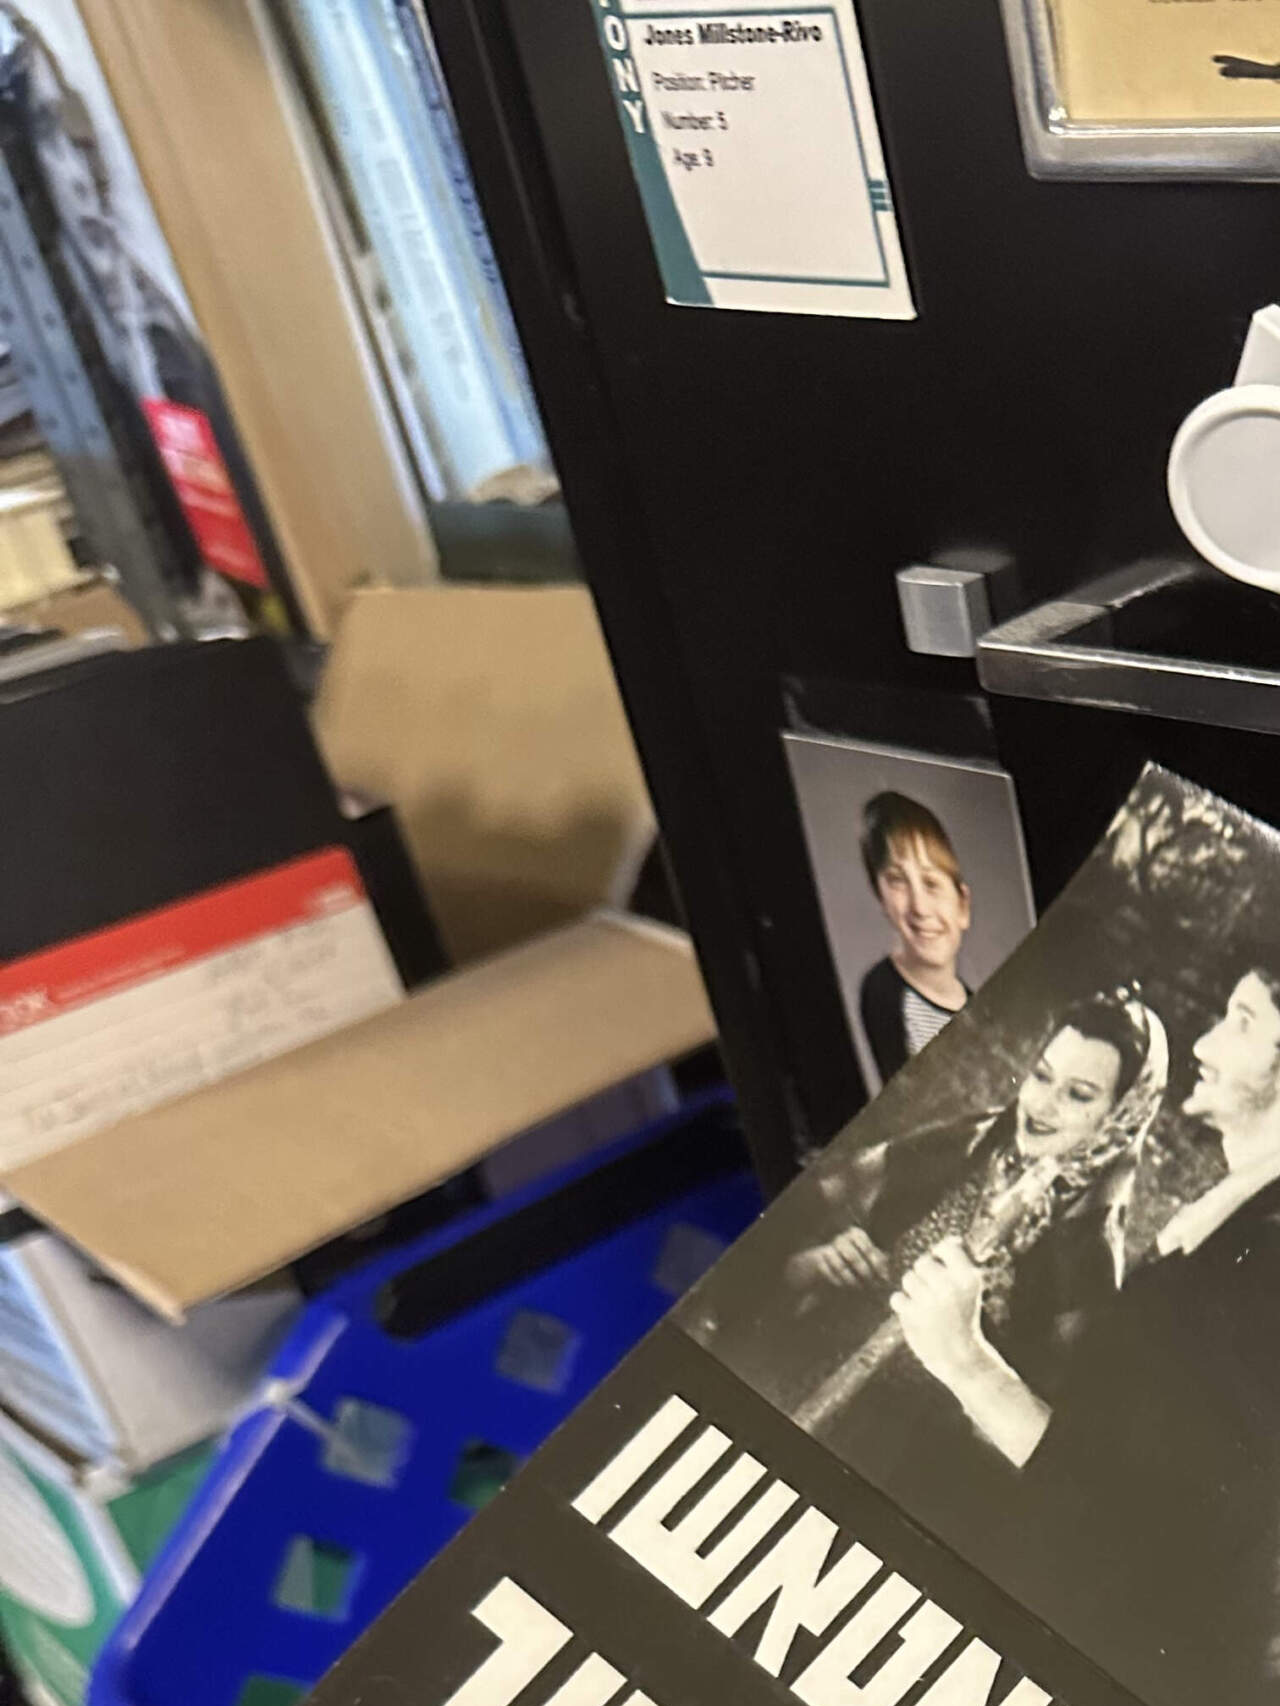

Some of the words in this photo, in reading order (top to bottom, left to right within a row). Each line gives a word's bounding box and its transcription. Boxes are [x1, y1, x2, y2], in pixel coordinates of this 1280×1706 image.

[643, 22, 694, 45] Jones
[697, 20, 823, 44] Millstone-Rivo
[598, 0, 646, 134] ONY
[708, 71, 756, 91] Pitcher
[716, 111, 728, 131] 5
